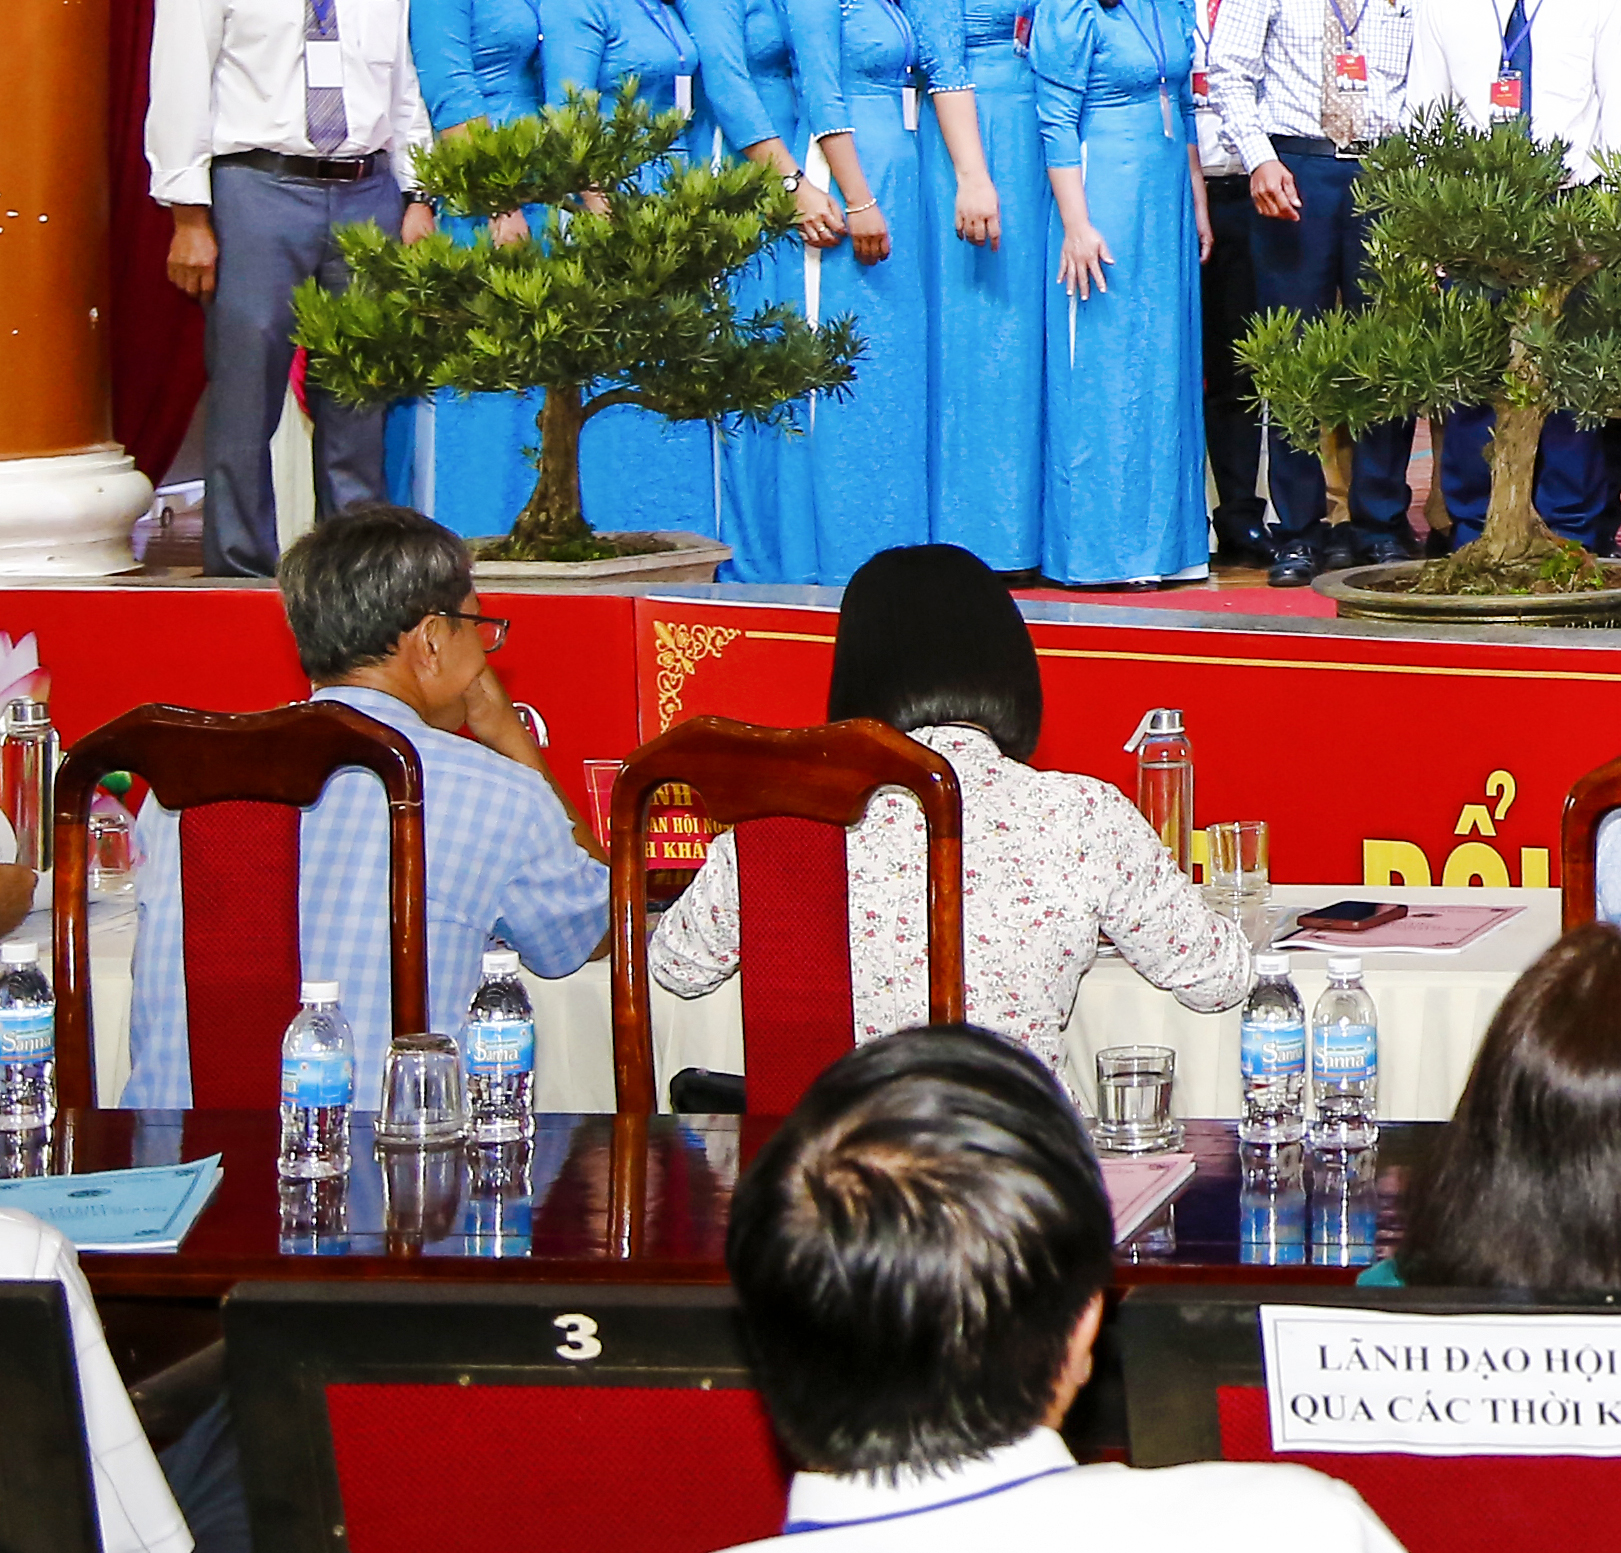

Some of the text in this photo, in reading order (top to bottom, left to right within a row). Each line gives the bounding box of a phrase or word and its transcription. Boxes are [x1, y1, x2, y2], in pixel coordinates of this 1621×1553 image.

[672, 814, 699, 837] HỘI
[1315, 1048, 1366, 1069] Sanna
[553, 1313, 603, 1361] 3
[1318, 1337, 1617, 1383] LÃNH ĐẠO HỘI
[1290, 1393, 1375, 1424] QUA
[1387, 1390, 1471, 1425] CÁC
[1482, 1392, 1582, 1426] THỜI
